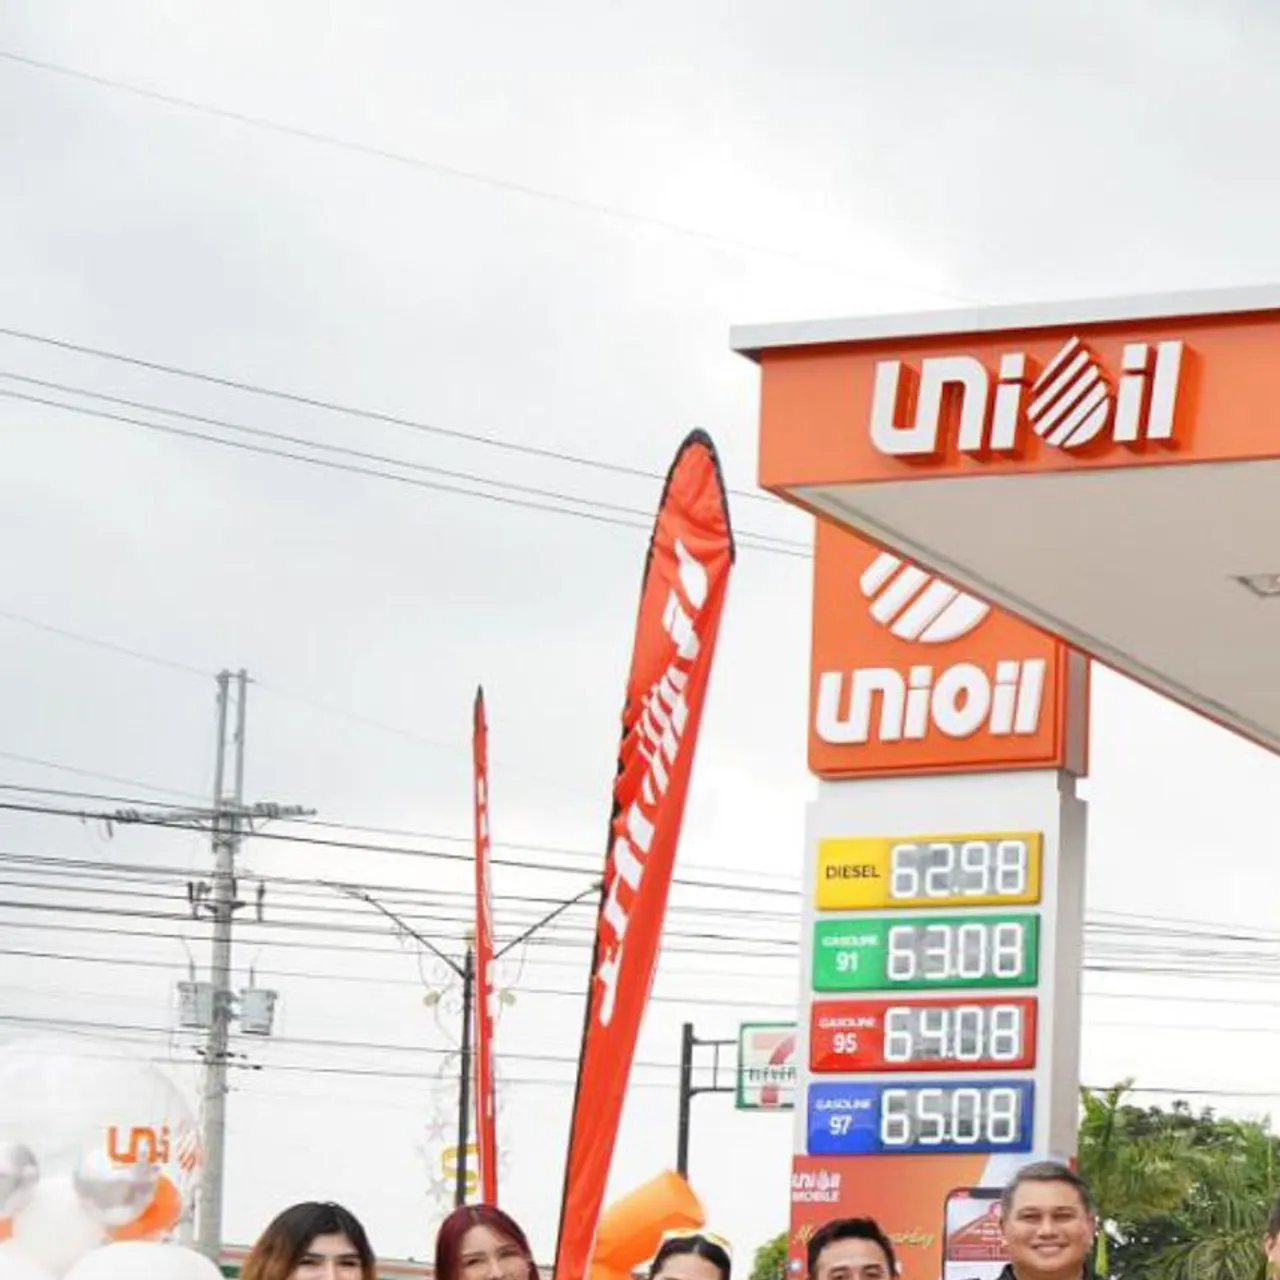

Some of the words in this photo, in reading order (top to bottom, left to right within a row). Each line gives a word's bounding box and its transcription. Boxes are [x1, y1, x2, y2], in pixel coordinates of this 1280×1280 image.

[826, 865, 881, 879] DIESEL
[891, 840, 1026, 898] 62.98
[822, 935, 879, 946] GASOLINE
[836, 952, 859, 971] 91
[887, 923, 1023, 980] 63.08
[818, 1017, 876, 1028] GASOLINE
[833, 1033, 857, 1054] 95
[884, 1005, 1020, 1062] 64.08
[816, 1098, 872, 1109] GASOLINE
[829, 1116, 852, 1136] 97
[881, 1088, 1016, 1144] 65.08
